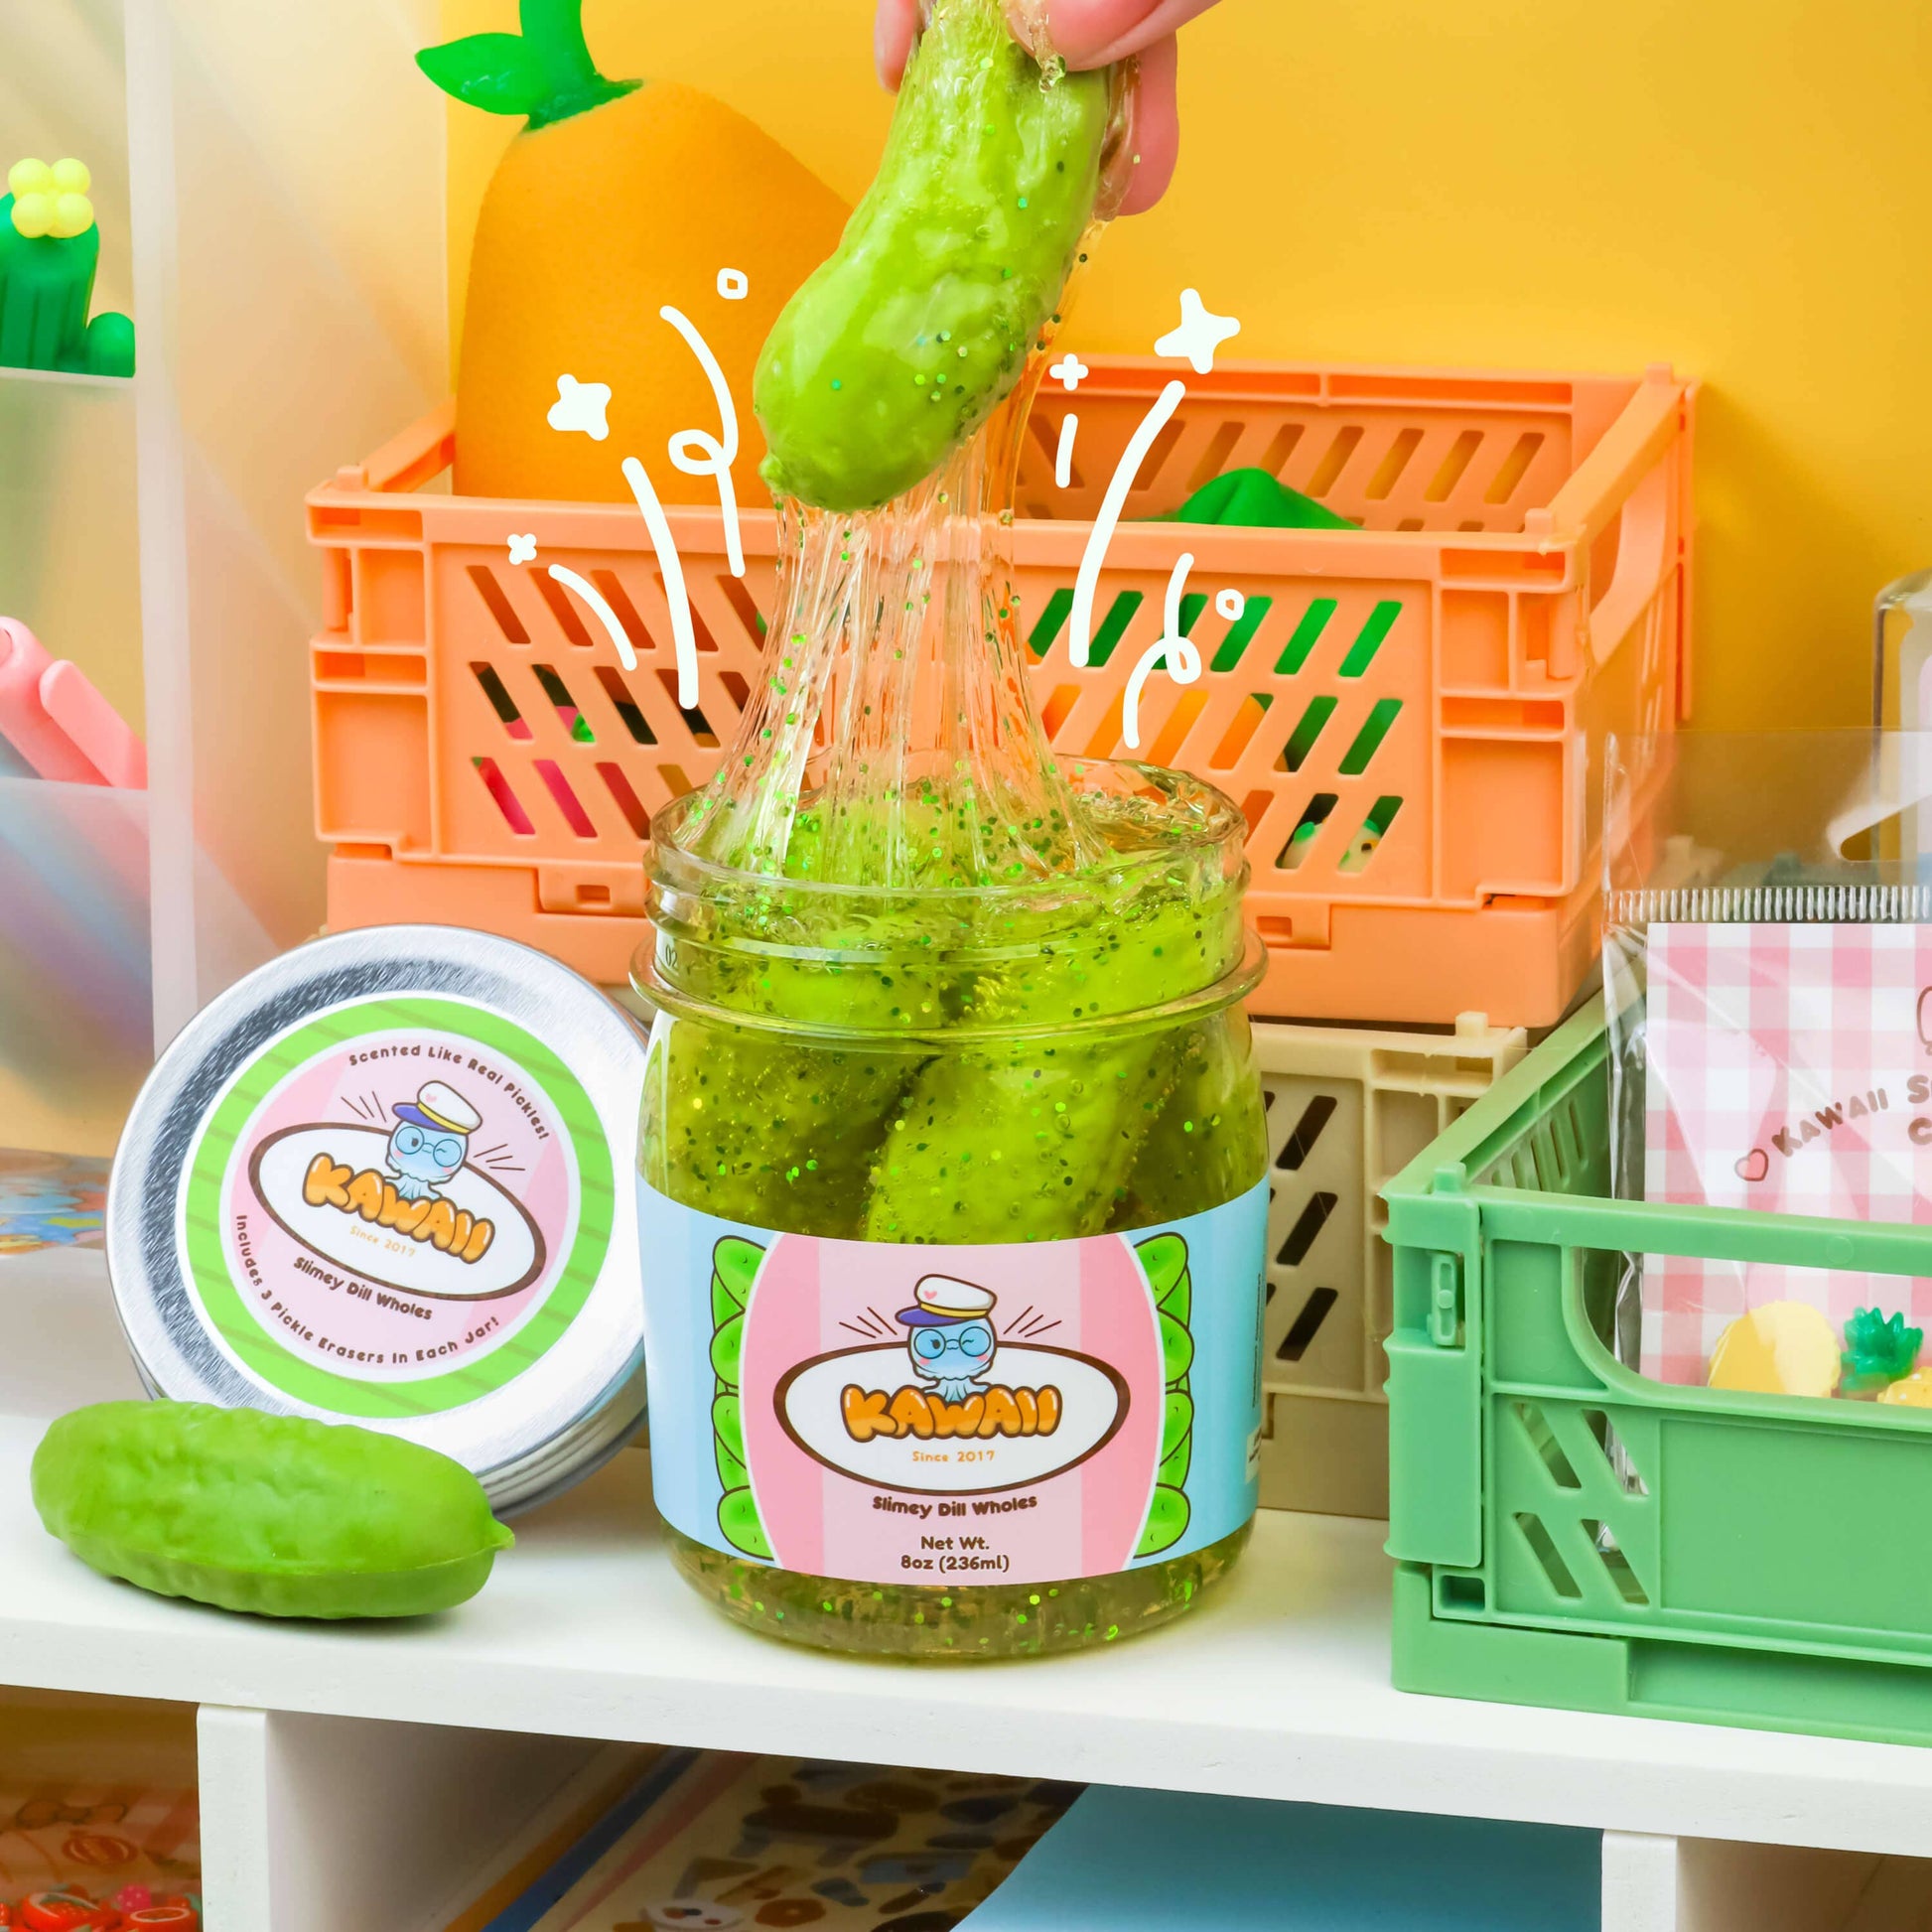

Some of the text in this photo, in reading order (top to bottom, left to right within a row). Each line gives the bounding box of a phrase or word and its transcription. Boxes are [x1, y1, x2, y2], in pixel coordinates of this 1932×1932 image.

[348, 1044, 550, 1140] Scented Like Real Pickles!
[1906, 1074, 1932, 1104] S
[1771, 1087, 1889, 1158] KAWAII
[302, 1152, 495, 1264] KAWAII
[349, 1225, 416, 1257] Since 2017
[235, 1214, 499, 1364] Includes 3 Pickle Erasers In Each Jar!
[293, 1256, 433, 1320] Slimey Dill Wholes
[840, 1383, 1063, 1443] KAWAII
[912, 1449, 996, 1463] Since 2017
[873, 1495, 1037, 1519] Slimey Dill Wholes
[900, 1555, 1010, 1574] 8oz (236ml)
[920, 1536, 990, 1550] Net Wt.
